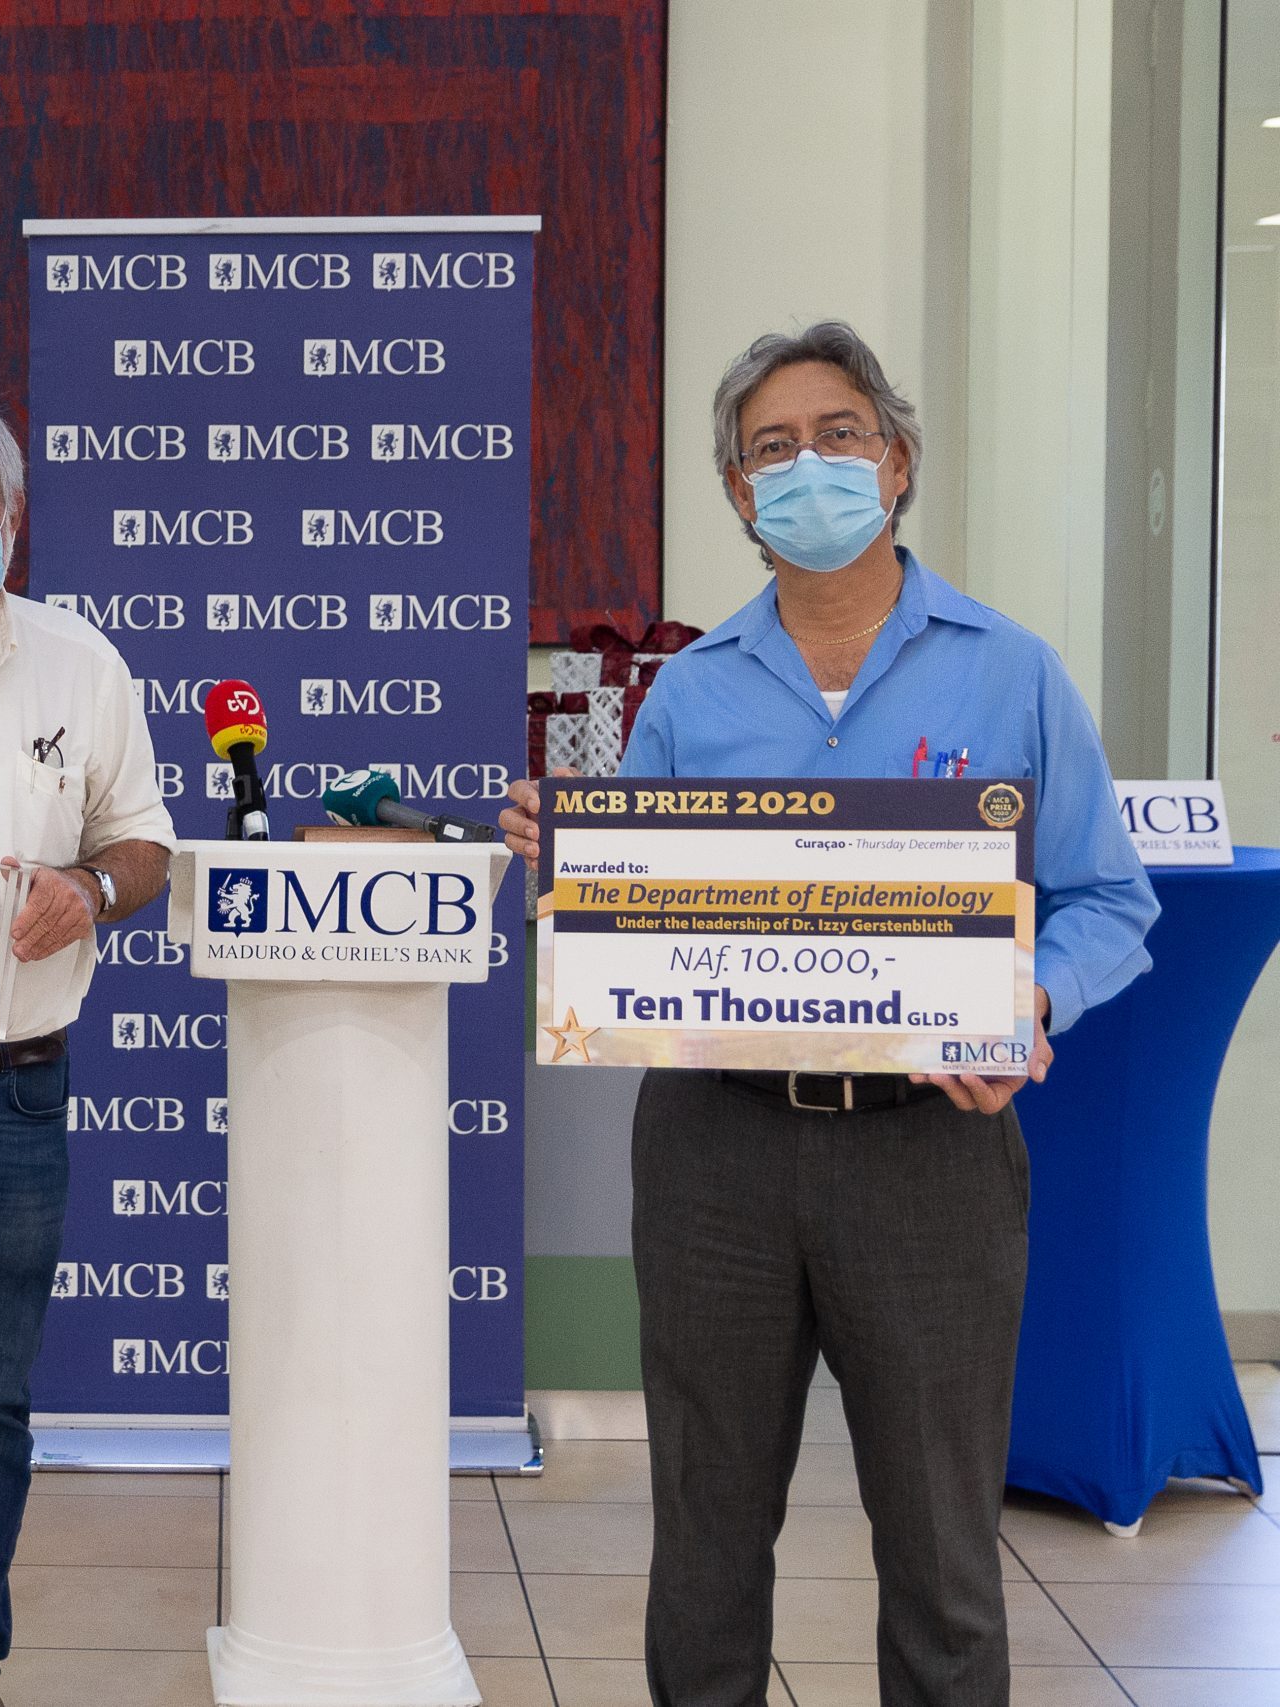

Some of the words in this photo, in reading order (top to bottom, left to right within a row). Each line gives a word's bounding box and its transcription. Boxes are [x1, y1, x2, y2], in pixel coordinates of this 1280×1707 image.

[82, 254, 187, 290] MCB
[246, 253, 351, 290] MCB
[410, 252, 516, 289] MCB
[150, 339, 255, 376] MCB
[340, 338, 446, 375] MCB
[82, 425, 186, 461] MCB
[244, 424, 350, 461] MCB
[408, 424, 514, 460] MCB
[149, 509, 254, 546] MCB
[338, 509, 444, 546] MCB
[81, 594, 185, 630] MCB
[242, 594, 348, 630] MCB
[407, 594, 512, 631] MCB
[148, 679, 221, 714] MC
[336, 679, 442, 715] MCB
[403, 763, 509, 799] MCB
[553, 790, 628, 814] MCB
[634, 790, 728, 814] PRIZE
[735, 791, 836, 815] 2020
[795, 838, 846, 851] Curaçao
[856, 838, 906, 852] Thursday
[909, 839, 964, 850] December
[967, 842, 980, 852] 17,
[982, 841, 1010, 850] 2020
[559, 861, 625, 874] Awarded
[628, 862, 649, 875] to:
[275, 870, 478, 936] MCB
[577, 882, 620, 904] The
[627, 883, 780, 911] Department
[786, 884, 817, 912] of
[820, 884, 994, 914] Epidemiology
[616, 916, 662, 929] Under
[664, 917, 689, 930] the
[692, 917, 771, 933] leadership
[773, 918, 790, 931] of
[792, 918, 815, 931] Dr.
[818, 919, 848, 935] Izzy
[851, 919, 954, 933] Gerstenbluth
[207, 944, 297, 961] MADURO
[301, 945, 317, 962] &
[321, 945, 411, 963] CURIEL'S
[416, 948, 473, 964] BANK
[670, 945, 730, 979] NAf.
[741, 947, 896, 980] 10.000,-
[608, 987, 683, 1021] Ten
[692, 986, 902, 1026] Thousand
[907, 1012, 959, 1027] GLDS
[149, 1014, 228, 1049] MC
[965, 1042, 1028, 1063] MCB
[81, 1096, 185, 1132] MCB
[448, 1099, 509, 1135] CB
[149, 1180, 228, 1216] MC
[81, 1262, 185, 1298] MCB
[448, 1265, 508, 1301] CB
[149, 1339, 229, 1375] MC
